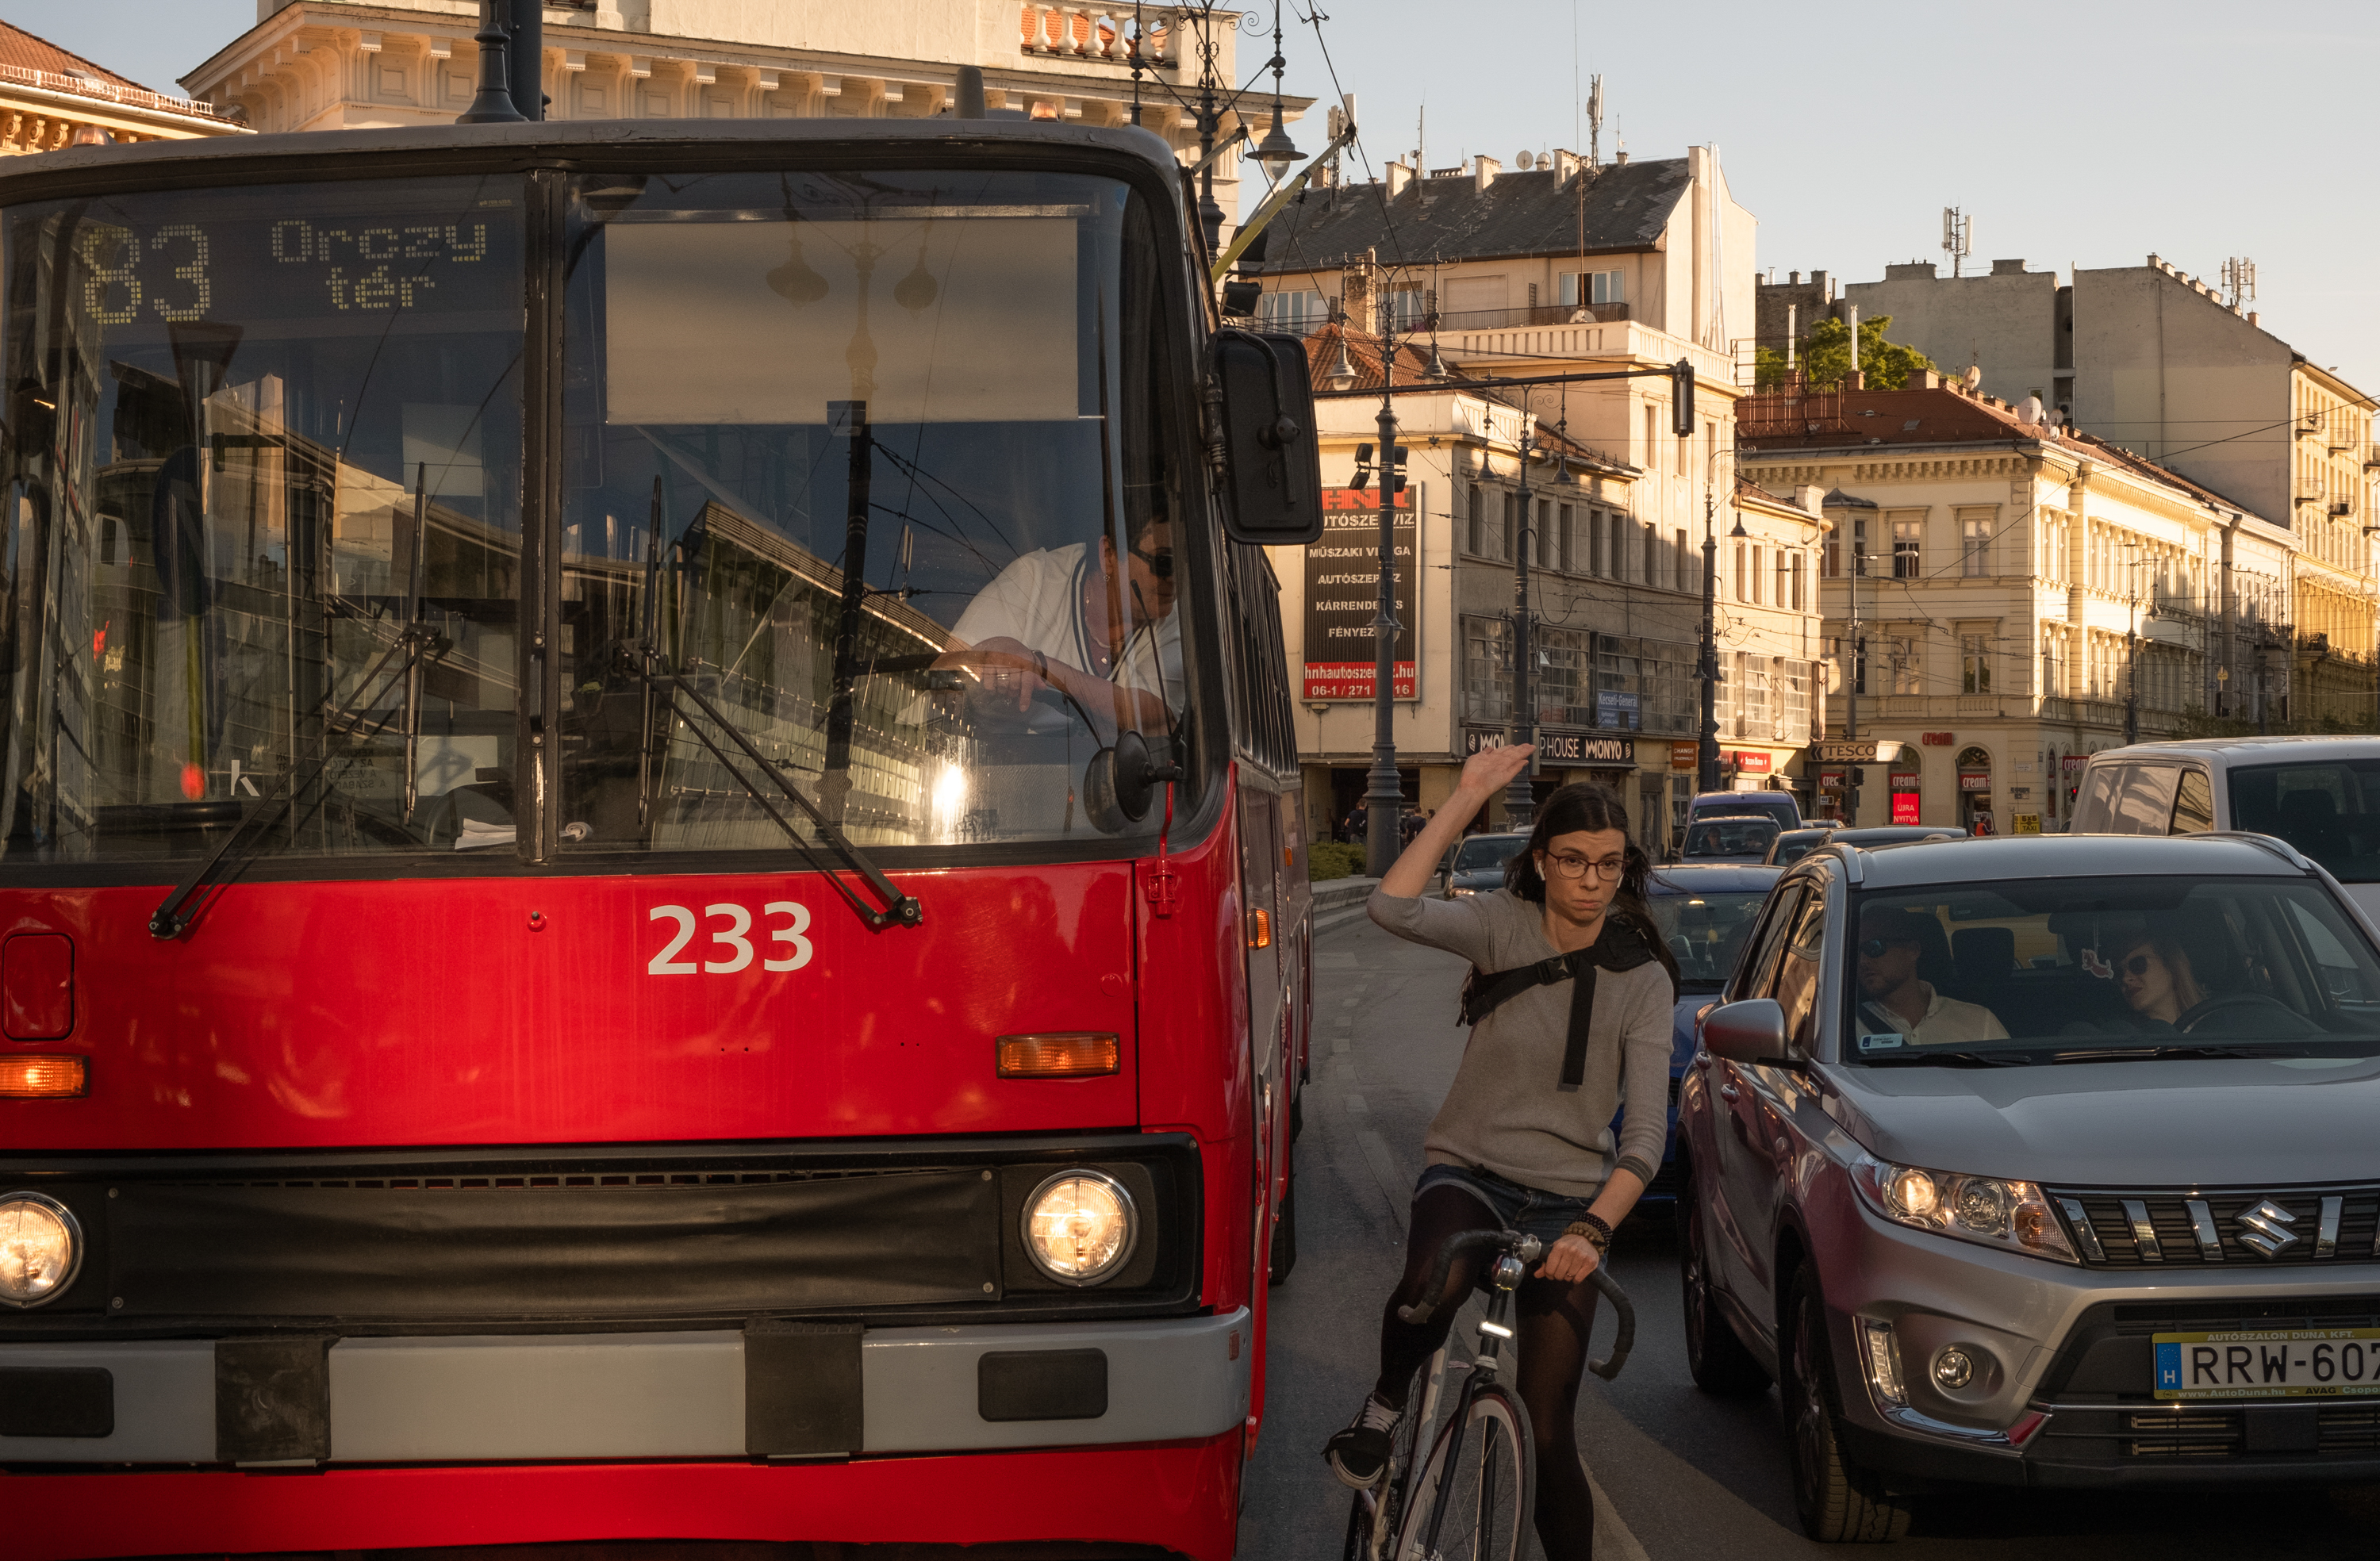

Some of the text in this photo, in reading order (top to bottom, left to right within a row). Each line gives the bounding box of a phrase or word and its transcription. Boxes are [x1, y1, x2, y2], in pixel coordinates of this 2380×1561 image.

[272, 220, 486, 263] Orczy
[84, 224, 211, 324] 83
[326, 266, 436, 310] tér
[1309, 545, 1411, 558] MŰSZAKI VIGA
[1317, 572, 1402, 585] AUTÓSZERZ
[1315, 599, 1403, 611] KÁRRENDES
[1311, 685, 1337, 696] 06-1
[1348, 685, 1371, 696] 271
[1921, 732, 1954, 746] cream
[1546, 737, 1580, 758] HOUSE
[1585, 738, 1622, 761] MONYO
[1825, 746, 1876, 757] TESCO
[1822, 776, 1839, 787] crea
[1892, 776, 1917, 787] cream
[1962, 777, 1987, 788] cream
[1897, 803, 1915, 812] ÚJRA
[1893, 815, 1919, 823] NYITVA
[647, 901, 813, 975] 233
[2207, 1332, 2288, 1342] AUTÓSZALON
[2163, 1369, 2175, 1384] H
[2178, 1389, 2286, 1398] www.AutoDuna.hu
[2305, 1386, 2336, 1395] AVAG
